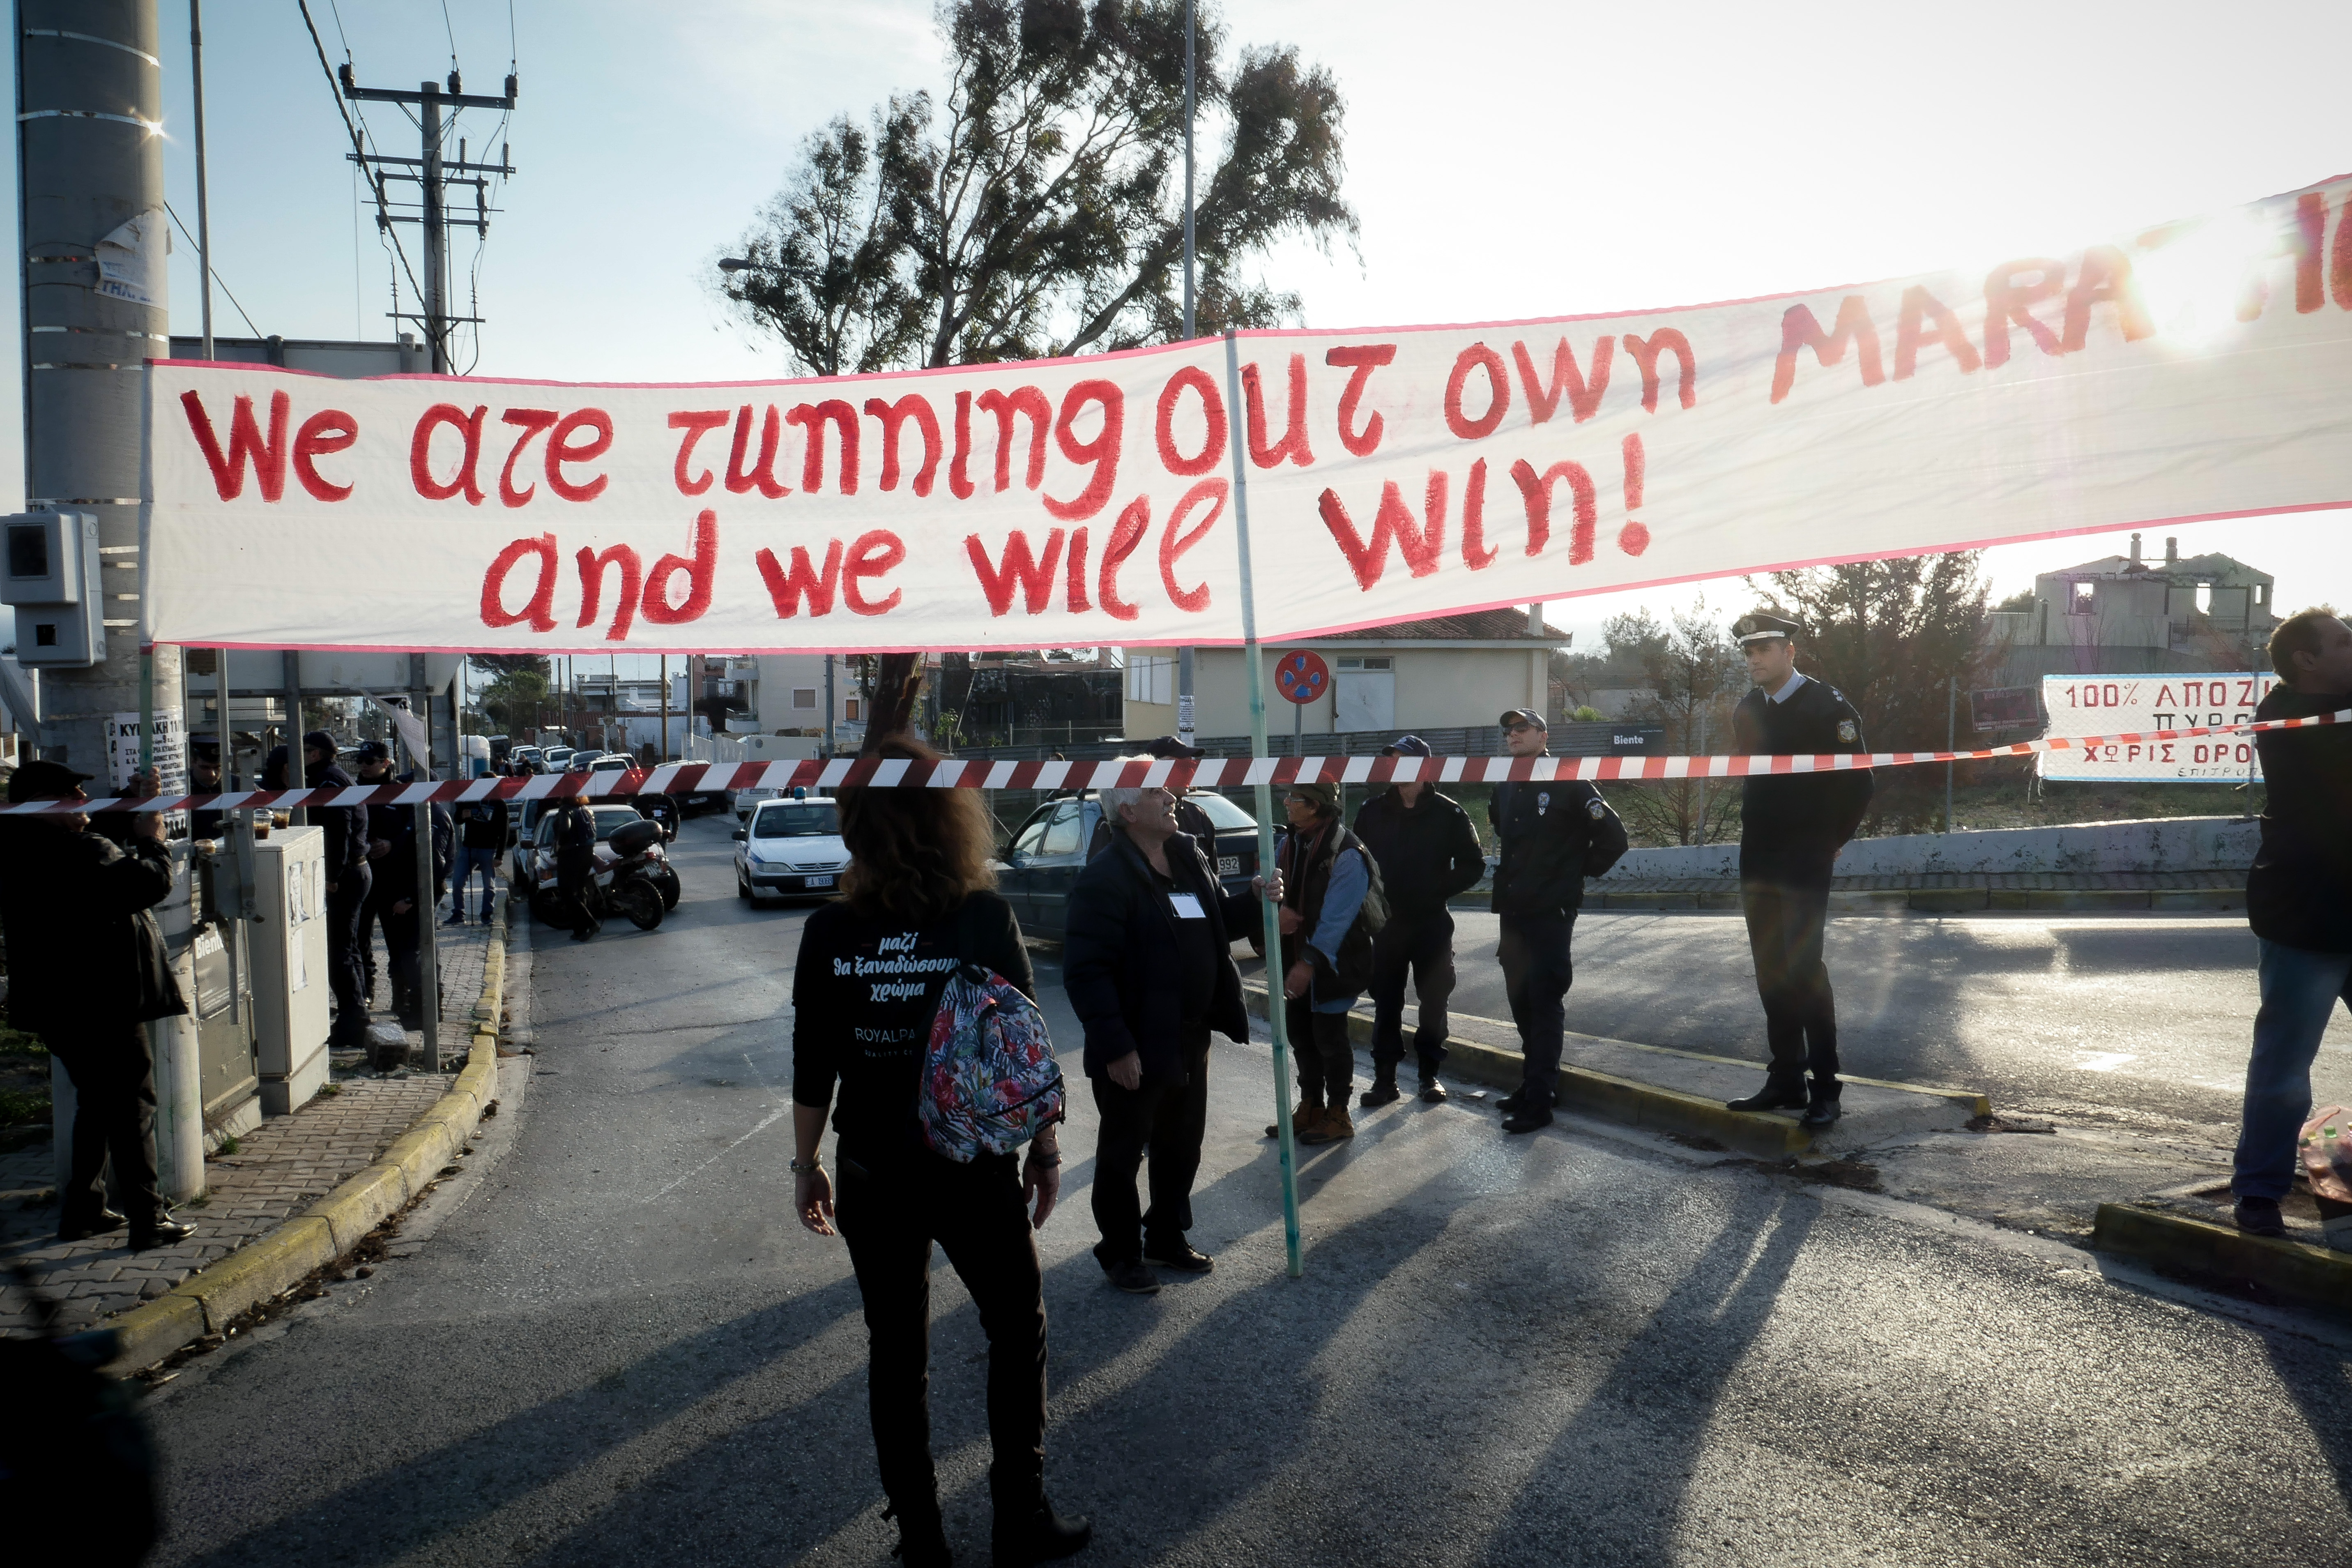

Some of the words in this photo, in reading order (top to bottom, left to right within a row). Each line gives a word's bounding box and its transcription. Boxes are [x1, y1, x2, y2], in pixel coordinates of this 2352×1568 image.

[180, 389, 358, 503] We
[1444, 327, 1696, 440] own
[480, 508, 718, 641] and
[755, 529, 906, 619] we
[963, 477, 1229, 622] will
[1318, 432, 1651, 592] win!
[2065, 682, 2139, 708] 100%
[1613, 734, 1644, 745] Biente
[878, 932, 919, 956] μαζί
[833, 957, 852, 976] θα
[870, 978, 925, 1002] χρώμα
